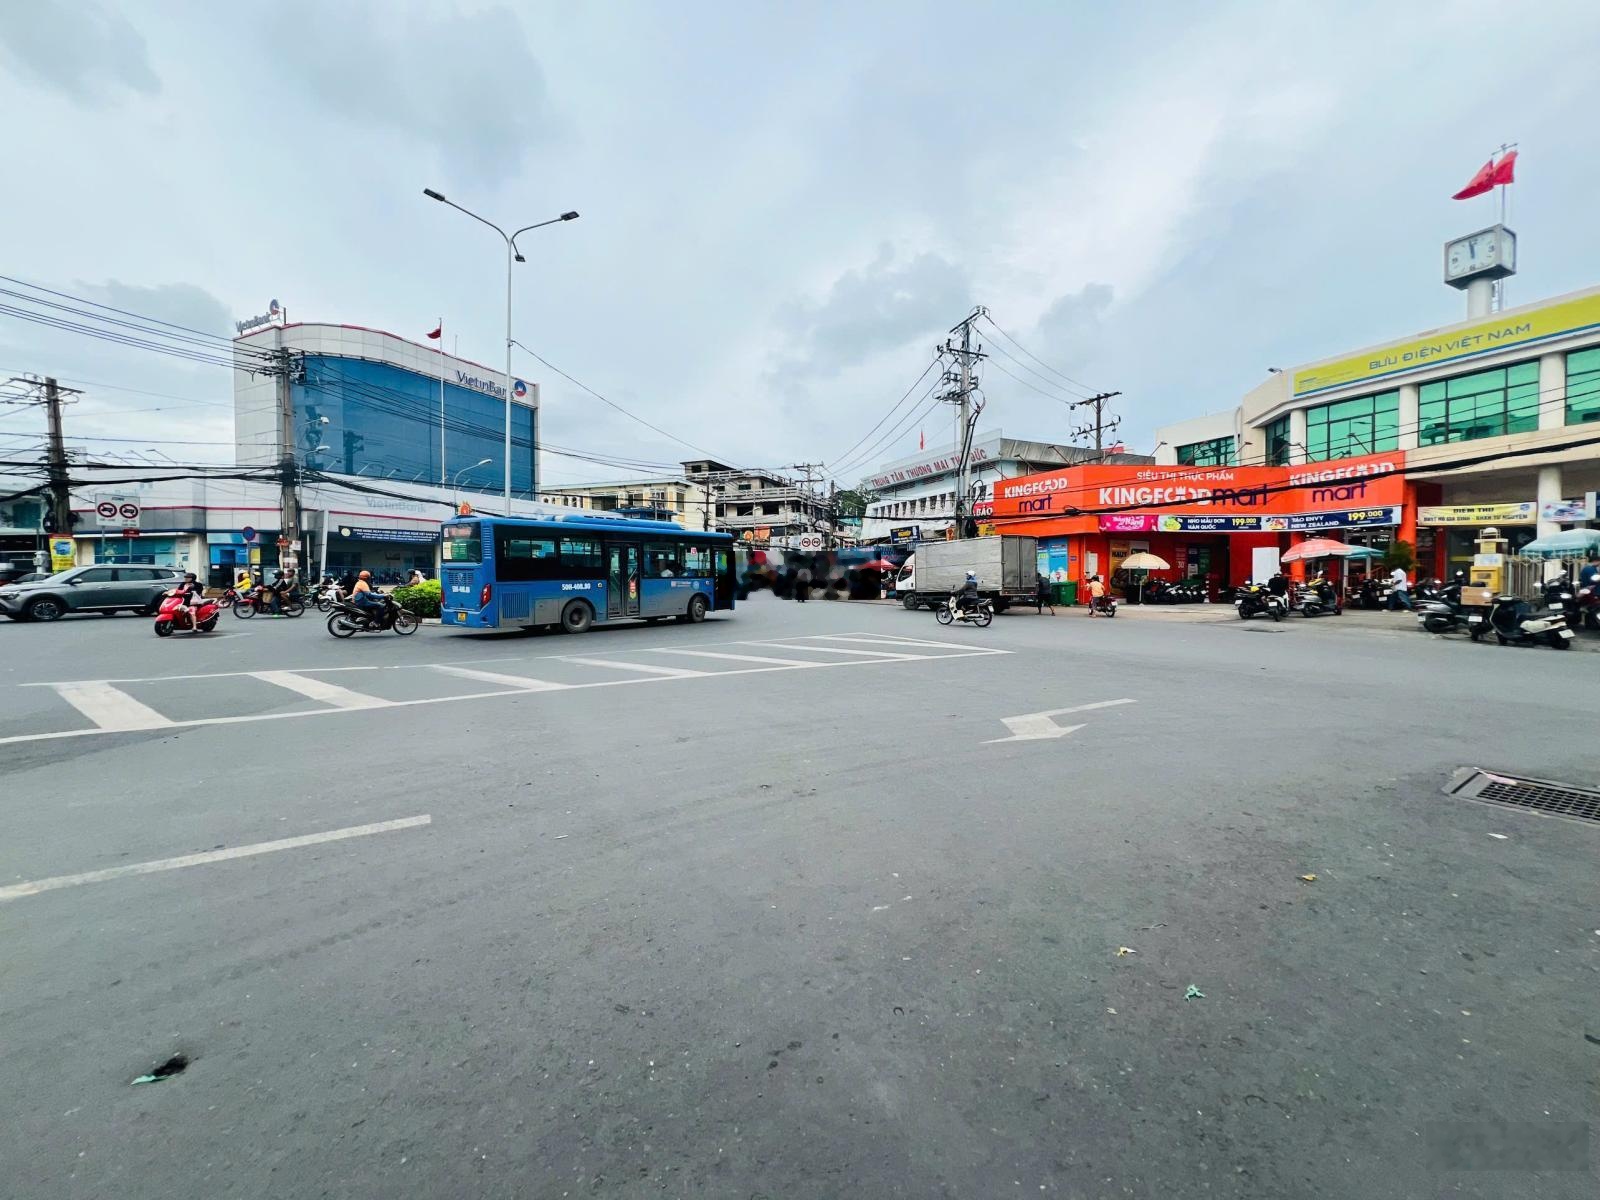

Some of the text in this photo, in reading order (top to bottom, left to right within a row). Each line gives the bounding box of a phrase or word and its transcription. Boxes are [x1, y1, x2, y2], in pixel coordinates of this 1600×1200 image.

[1369, 323, 1531, 370] BƯU ĐIỆN VIỆT NAM
[871, 475, 890, 488] TRUNG
[1137, 469, 1234, 482] SIÊU THỊ THỰC PHẨM
[1289, 462, 1395, 486] KINGFOOD
[1004, 478, 1067, 498] KINGFOOD
[1313, 480, 1367, 503] mart
[1019, 494, 1052, 512] mart
[1232, 518, 1257, 526] 199.000
